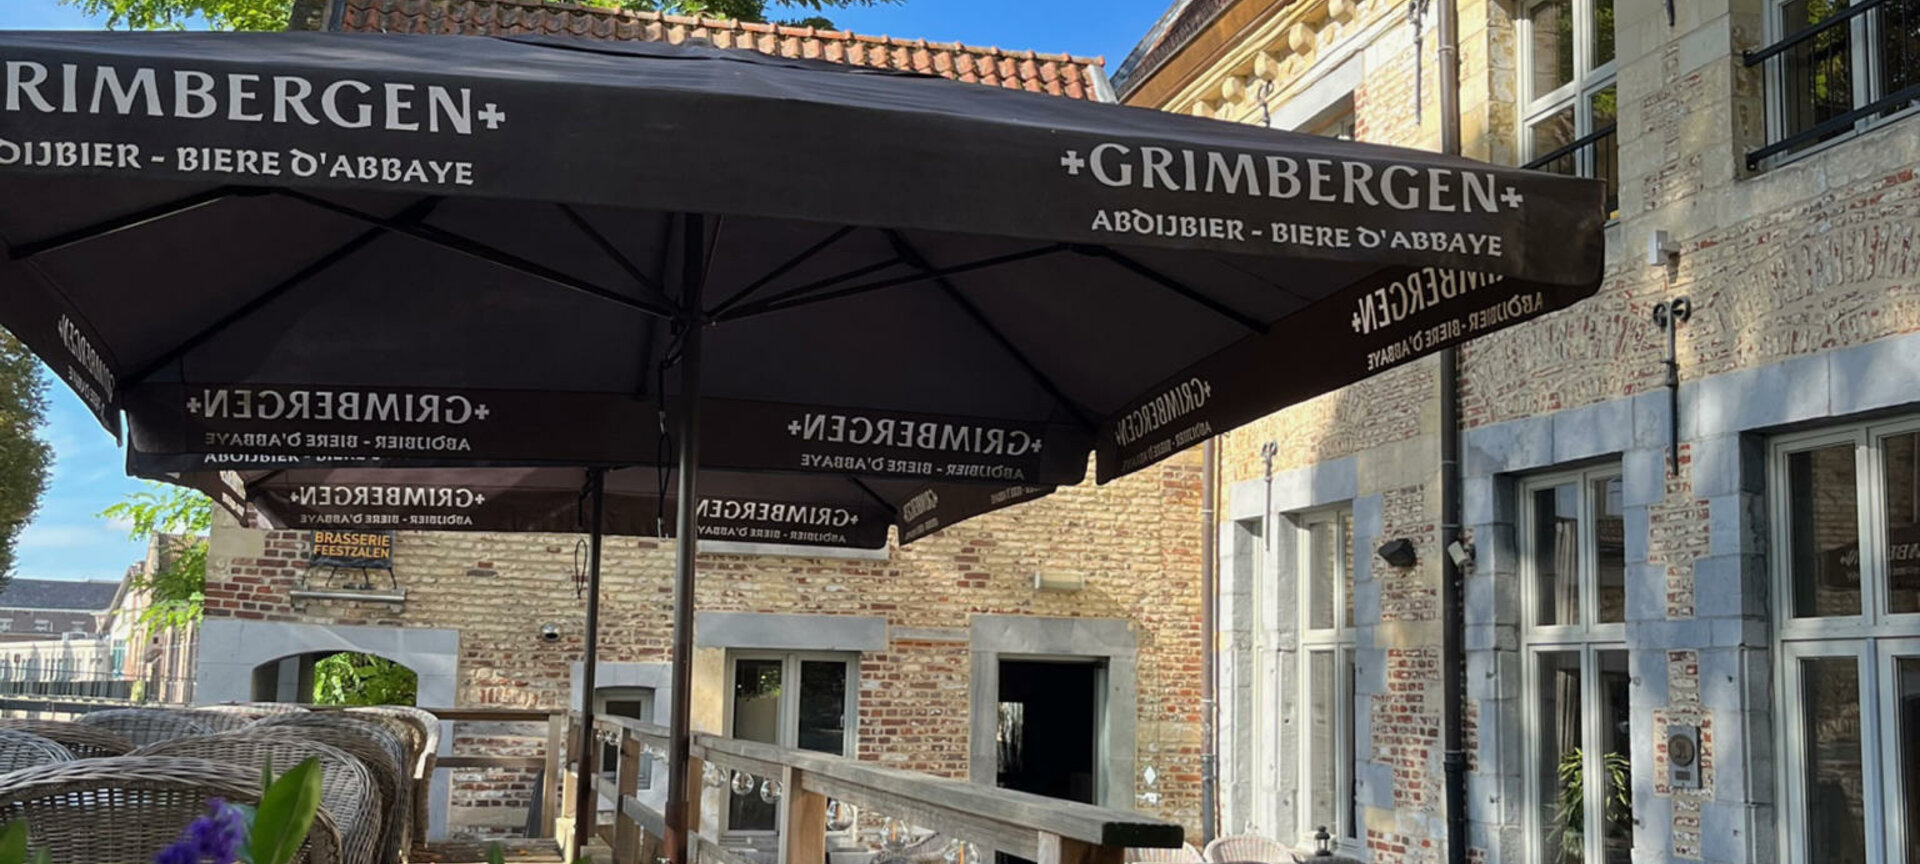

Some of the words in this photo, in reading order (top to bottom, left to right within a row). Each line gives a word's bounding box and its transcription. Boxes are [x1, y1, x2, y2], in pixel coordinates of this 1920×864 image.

[5, 60, 472, 134] RIMBERGEN
[177, 146, 281, 176] BIERE
[291, 148, 475, 185] D'ABBAYE
[1089, 142, 1500, 213] GRIMBERGEN
[1091, 208, 1245, 242] ABDIJBIER
[1271, 223, 1352, 249] BIERE
[1357, 226, 1503, 256] D'ABBAYE
[313, 544, 390, 559] FEESTZALEN
[314, 531, 391, 547] BRASSERIE
